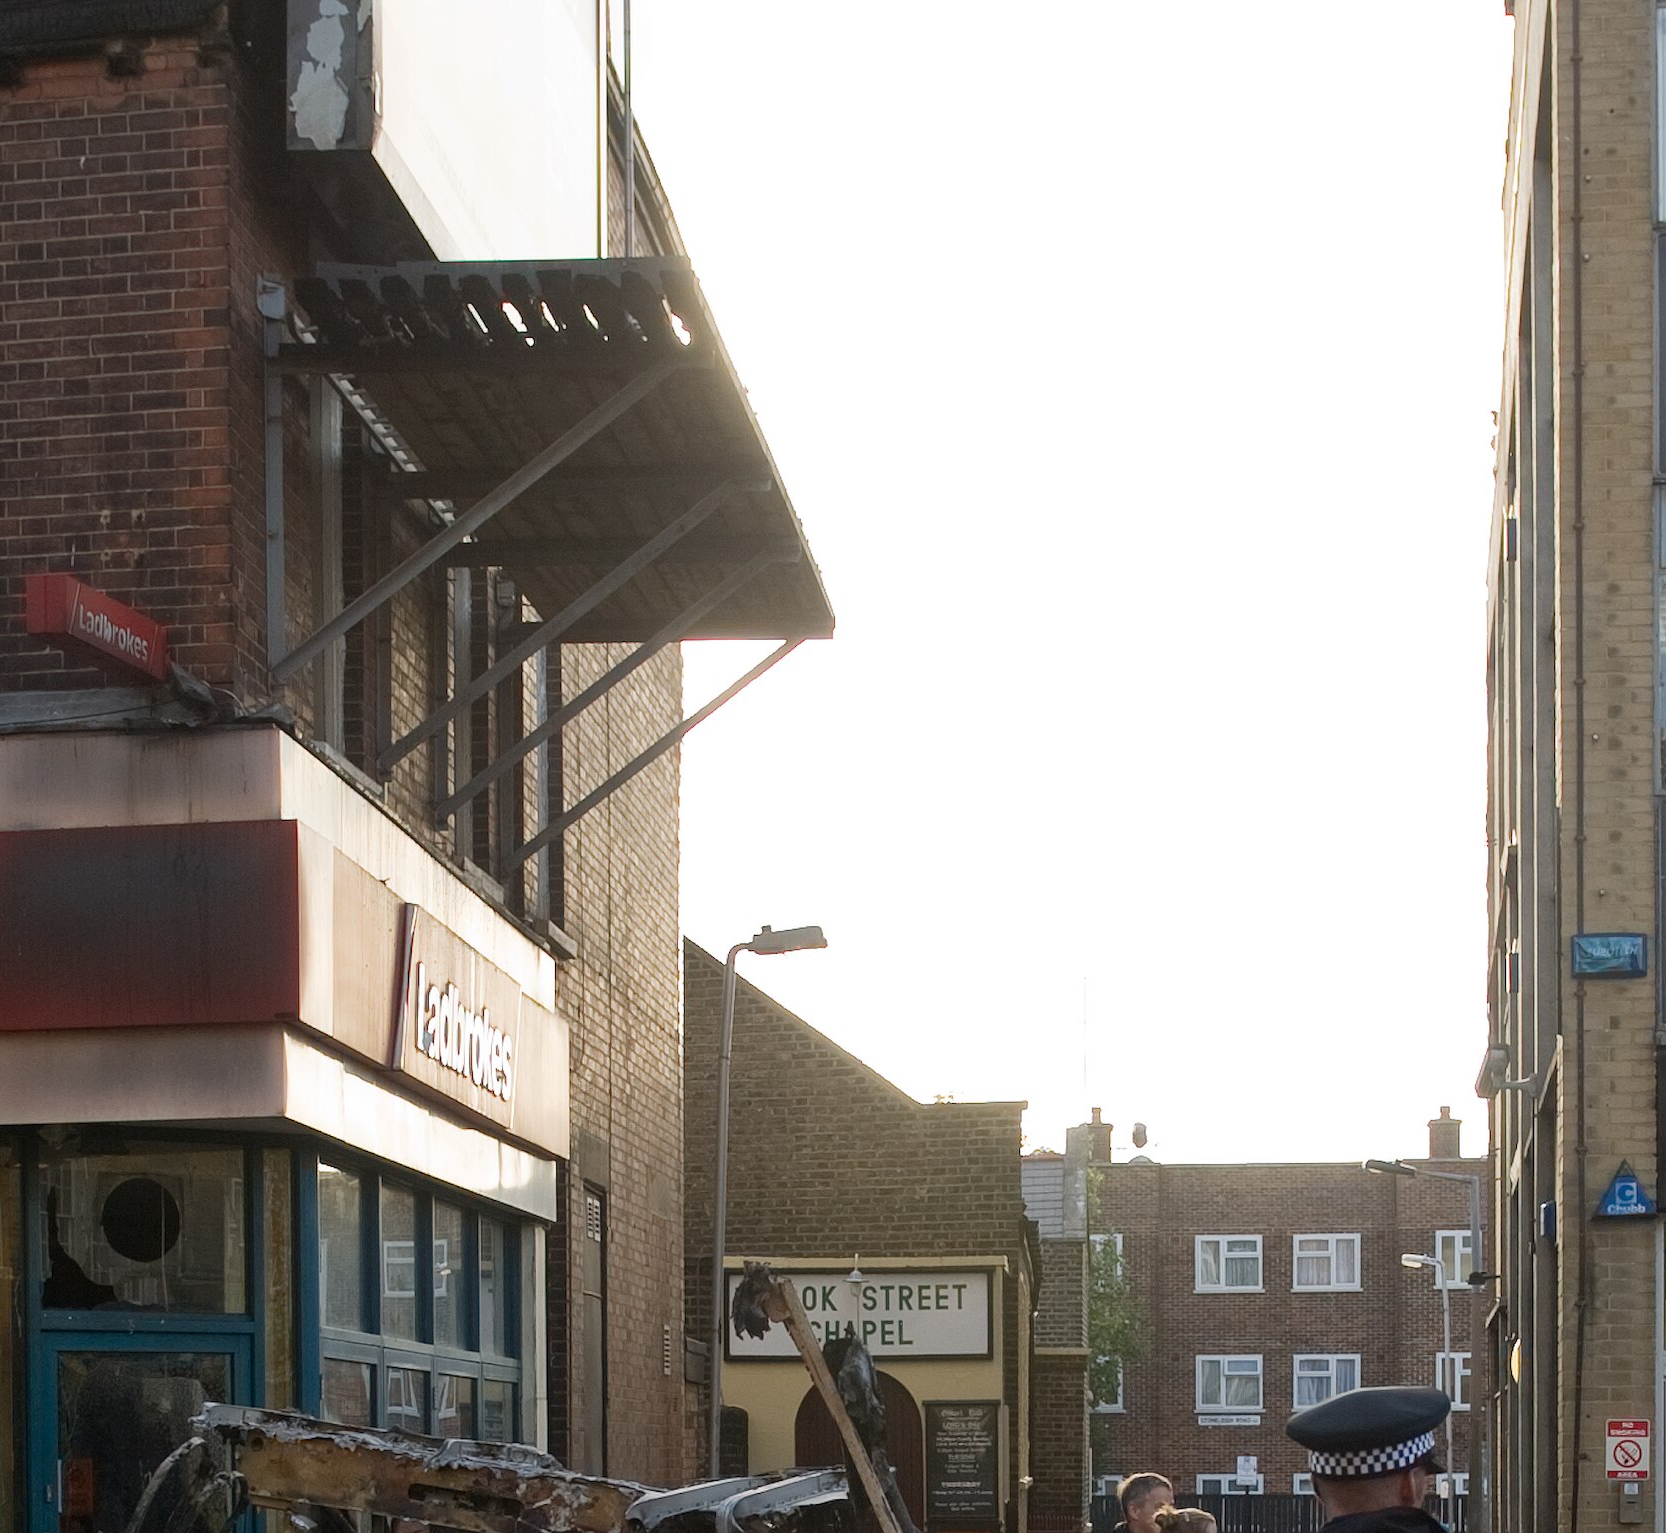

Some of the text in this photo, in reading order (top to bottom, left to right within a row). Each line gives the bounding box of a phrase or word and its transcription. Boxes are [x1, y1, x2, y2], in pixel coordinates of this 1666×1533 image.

[79, 604, 149, 660] Ladbrokes
[414, 961, 513, 1101] Ladbrokes
[1606, 1203, 1647, 1214] Chubb
[861, 1284, 967, 1311] STREET
